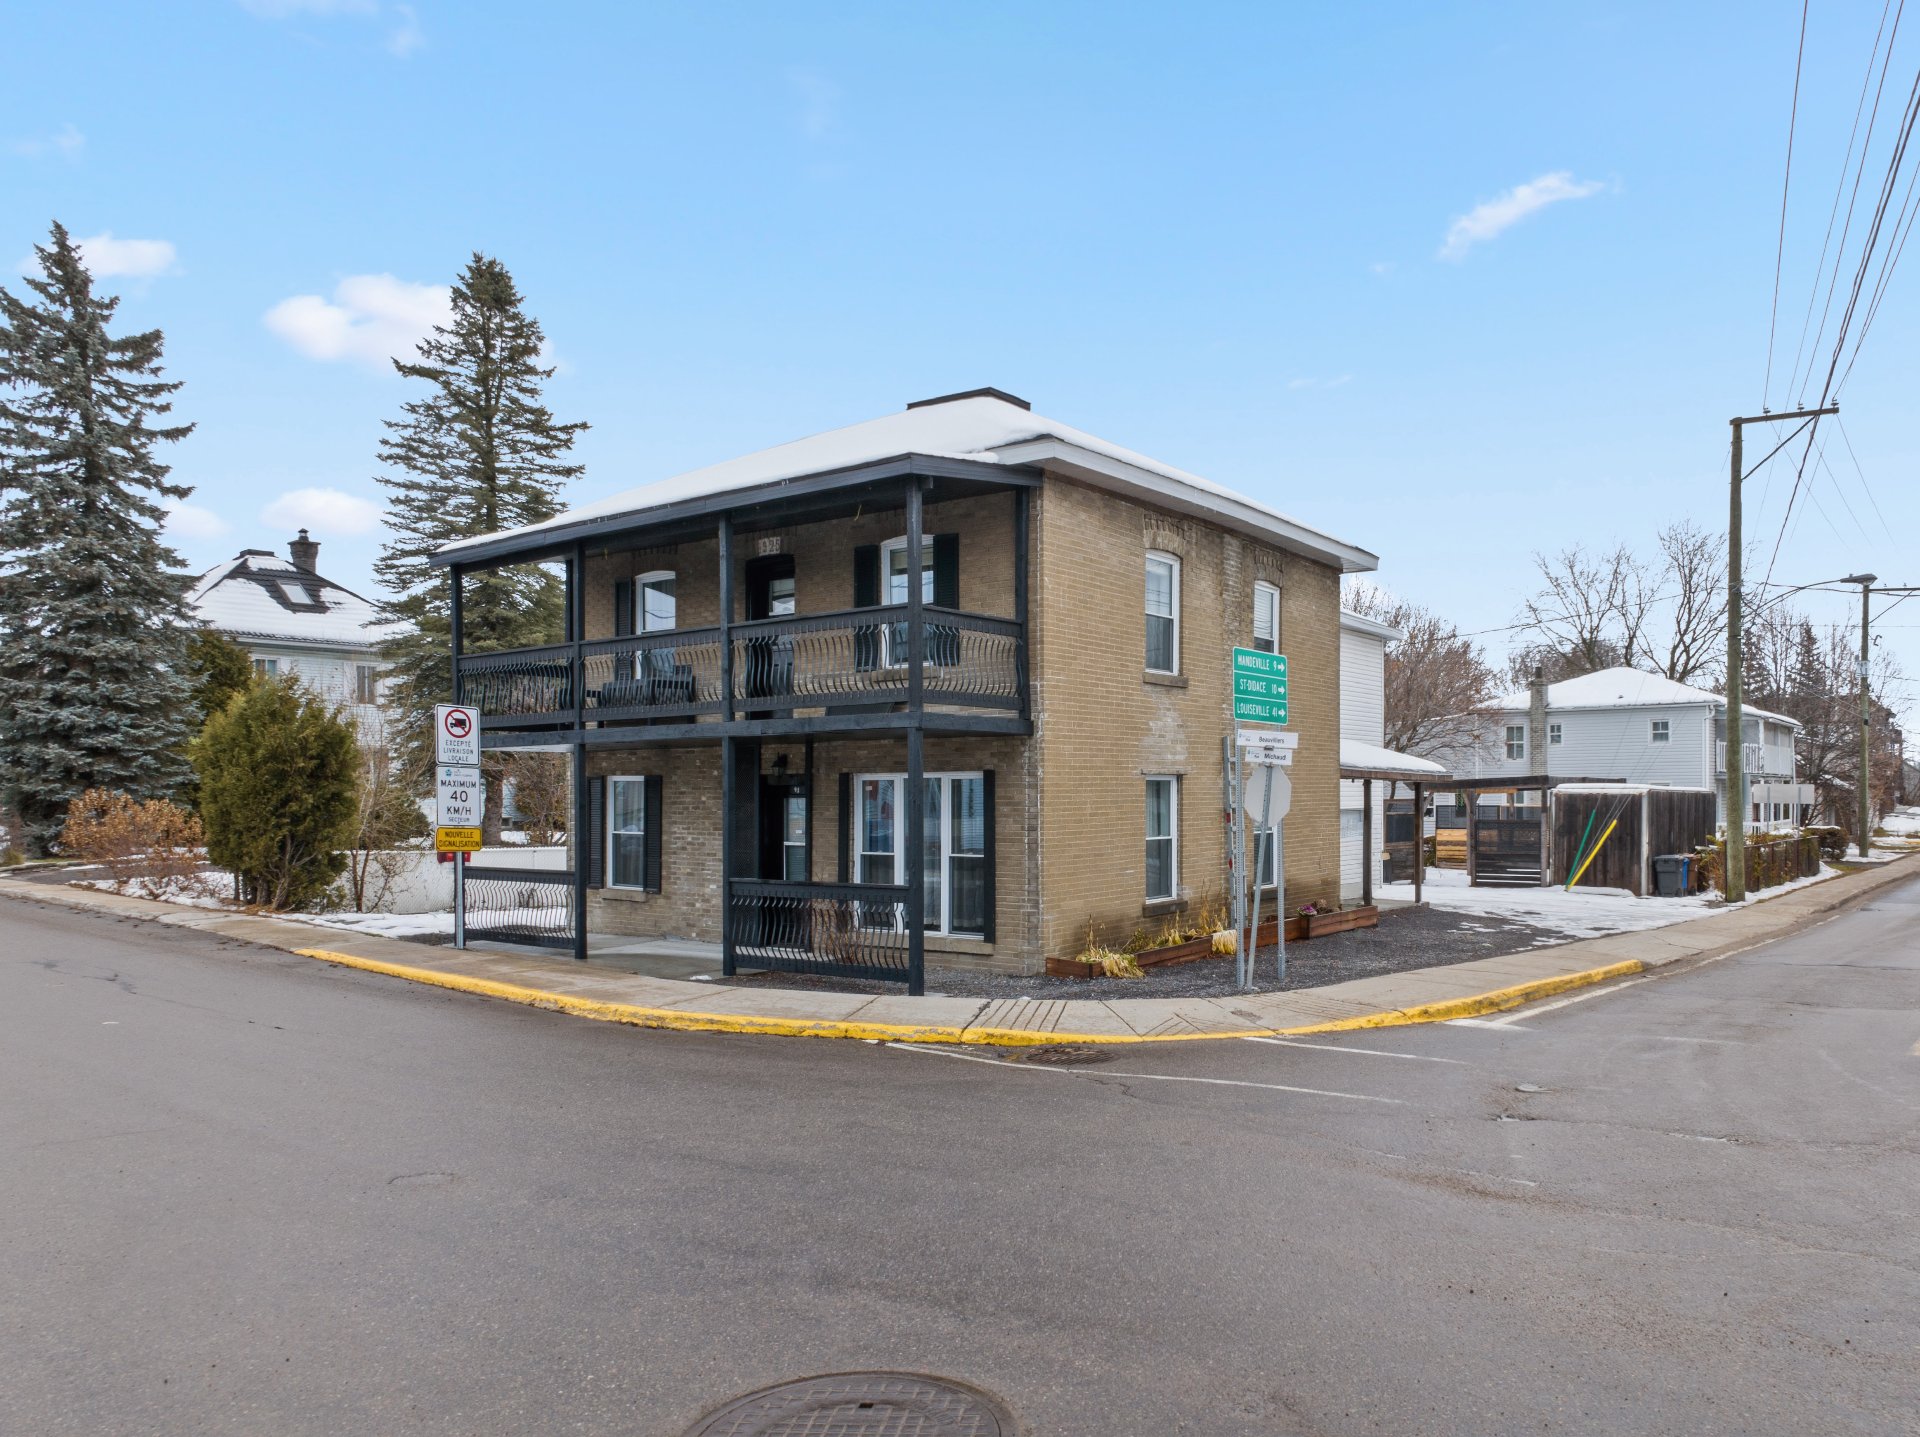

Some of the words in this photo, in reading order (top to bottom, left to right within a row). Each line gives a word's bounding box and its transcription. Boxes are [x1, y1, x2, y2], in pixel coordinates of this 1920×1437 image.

[1237, 654, 1270, 671] MANDEVILLE
[1271, 683, 1278, 695] 10
[1236, 702, 1270, 717] LOUISEVILLE
[1272, 706, 1278, 717] 41
[443, 747, 474, 755] LIVRAISON
[1264, 753, 1286, 761] Michaud
[440, 779, 477, 788] MAXIMUM
[450, 790, 468, 803] 40
[446, 805, 472, 816] KM/H
[444, 830, 474, 839] NOUVELLE
[438, 839, 480, 849] SIGNALISATION
